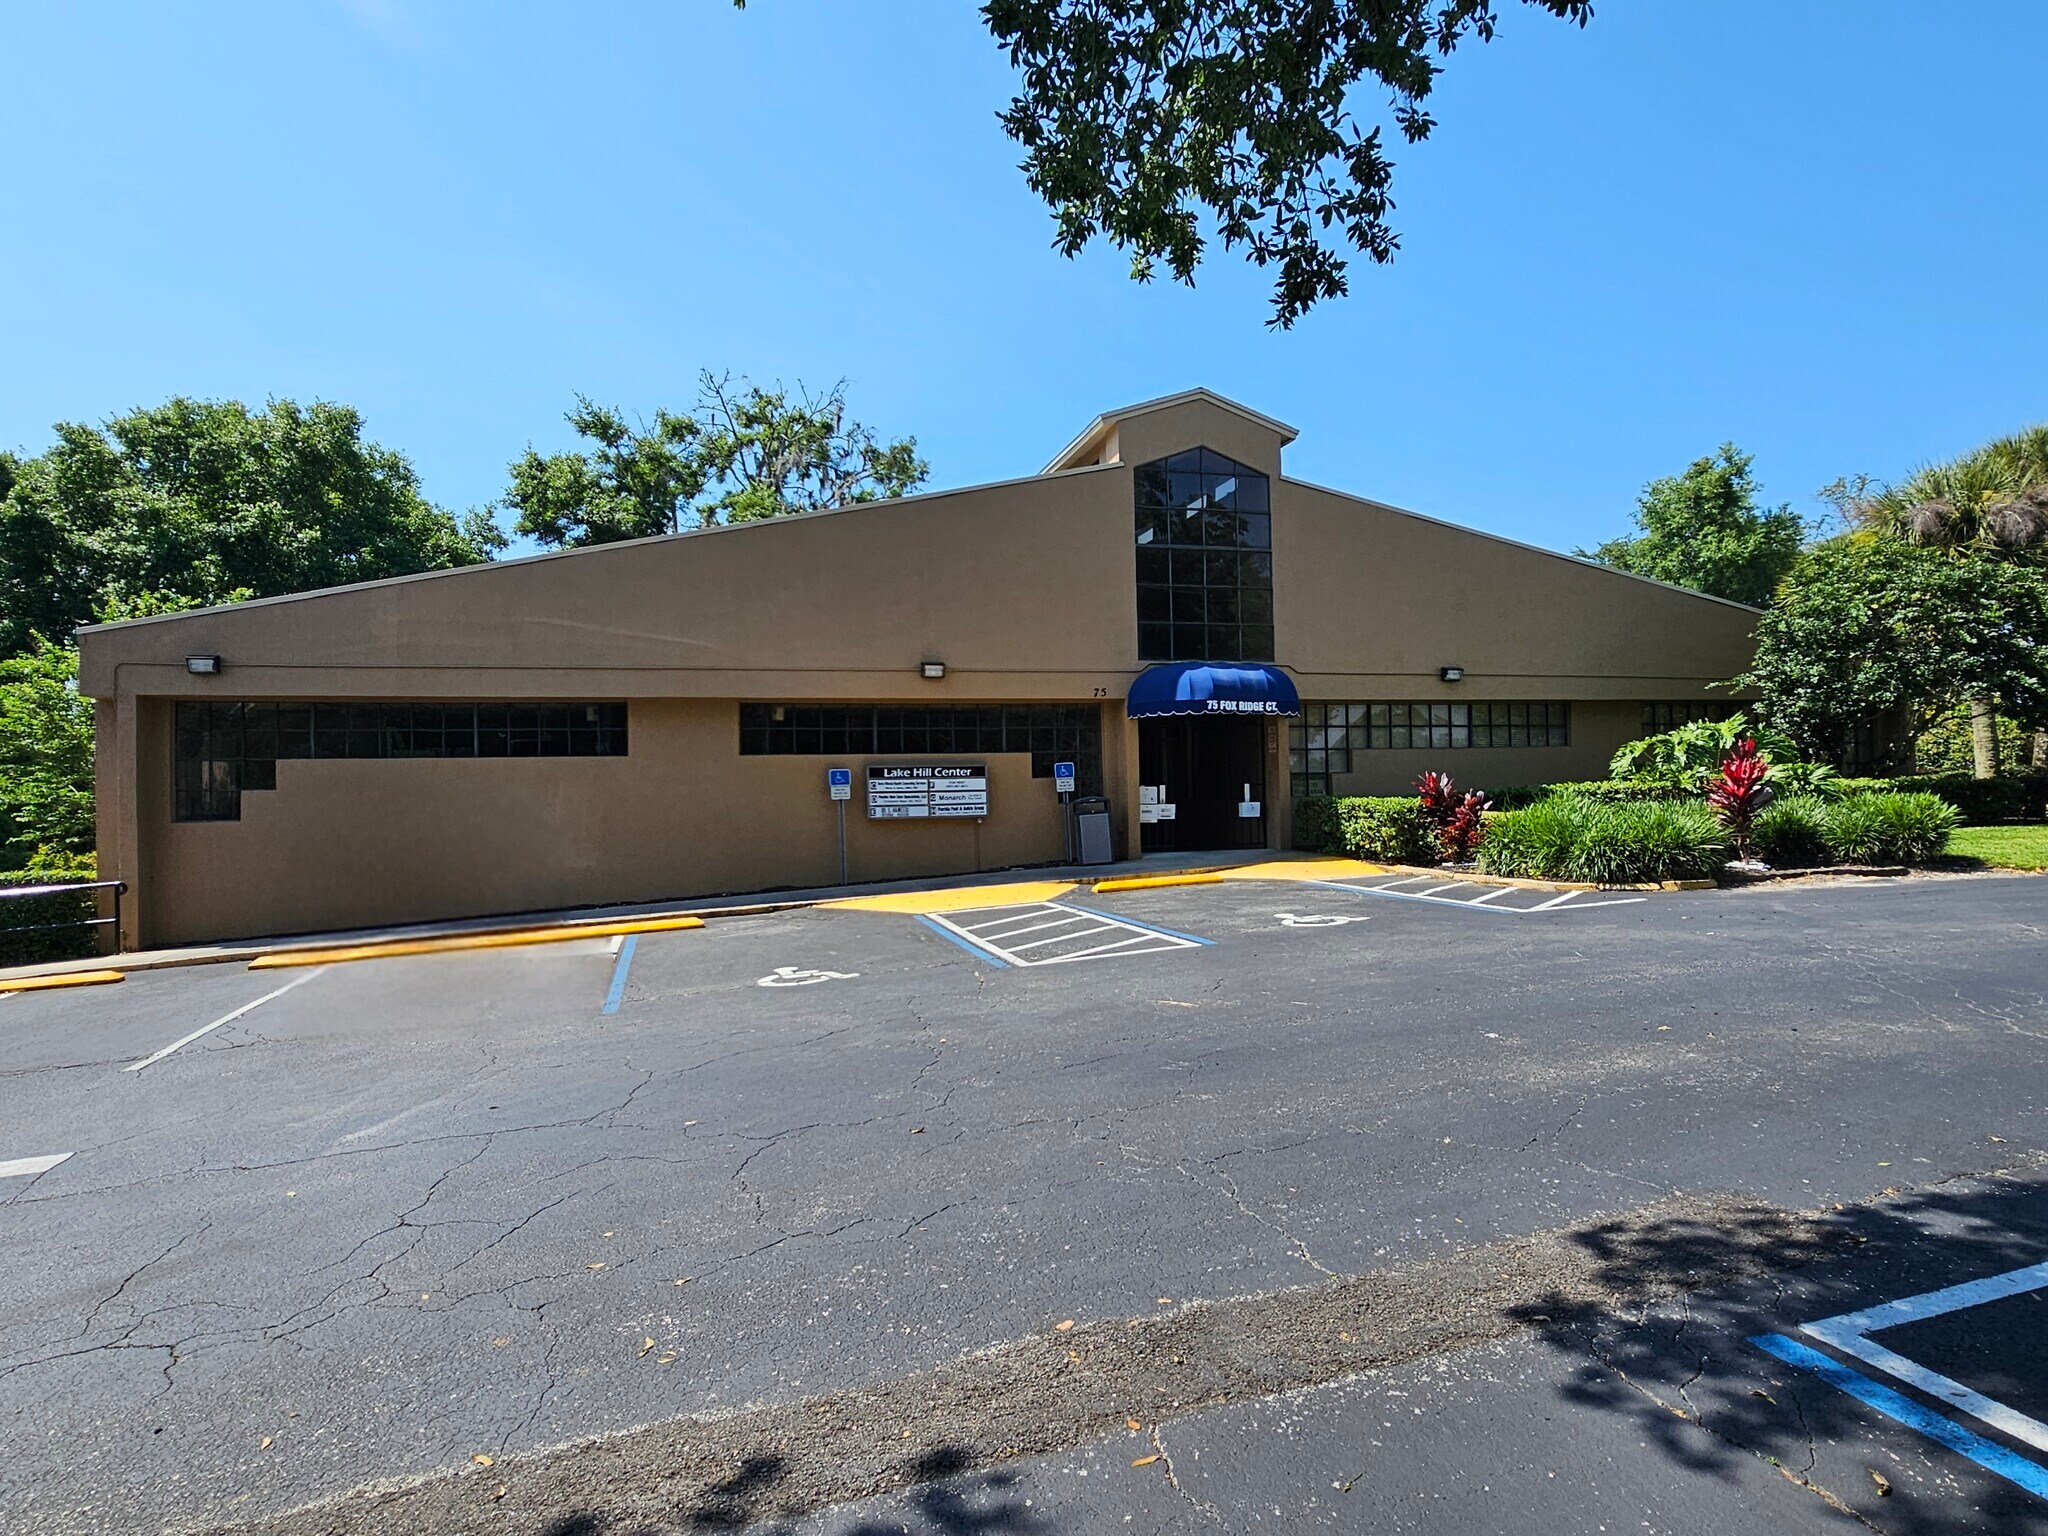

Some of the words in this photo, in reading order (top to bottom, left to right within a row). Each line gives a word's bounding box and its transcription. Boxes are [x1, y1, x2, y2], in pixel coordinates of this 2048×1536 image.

[1093, 687, 1107, 698] 75
[1206, 699, 1219, 710] 75
[1219, 700, 1238, 711] FOX
[1238, 701, 1265, 712] RIDGE
[1265, 701, 1279, 712] CT.
[883, 768, 911, 778] Lake
[913, 767, 932, 778] Hill
[934, 767, 972, 777] Center
